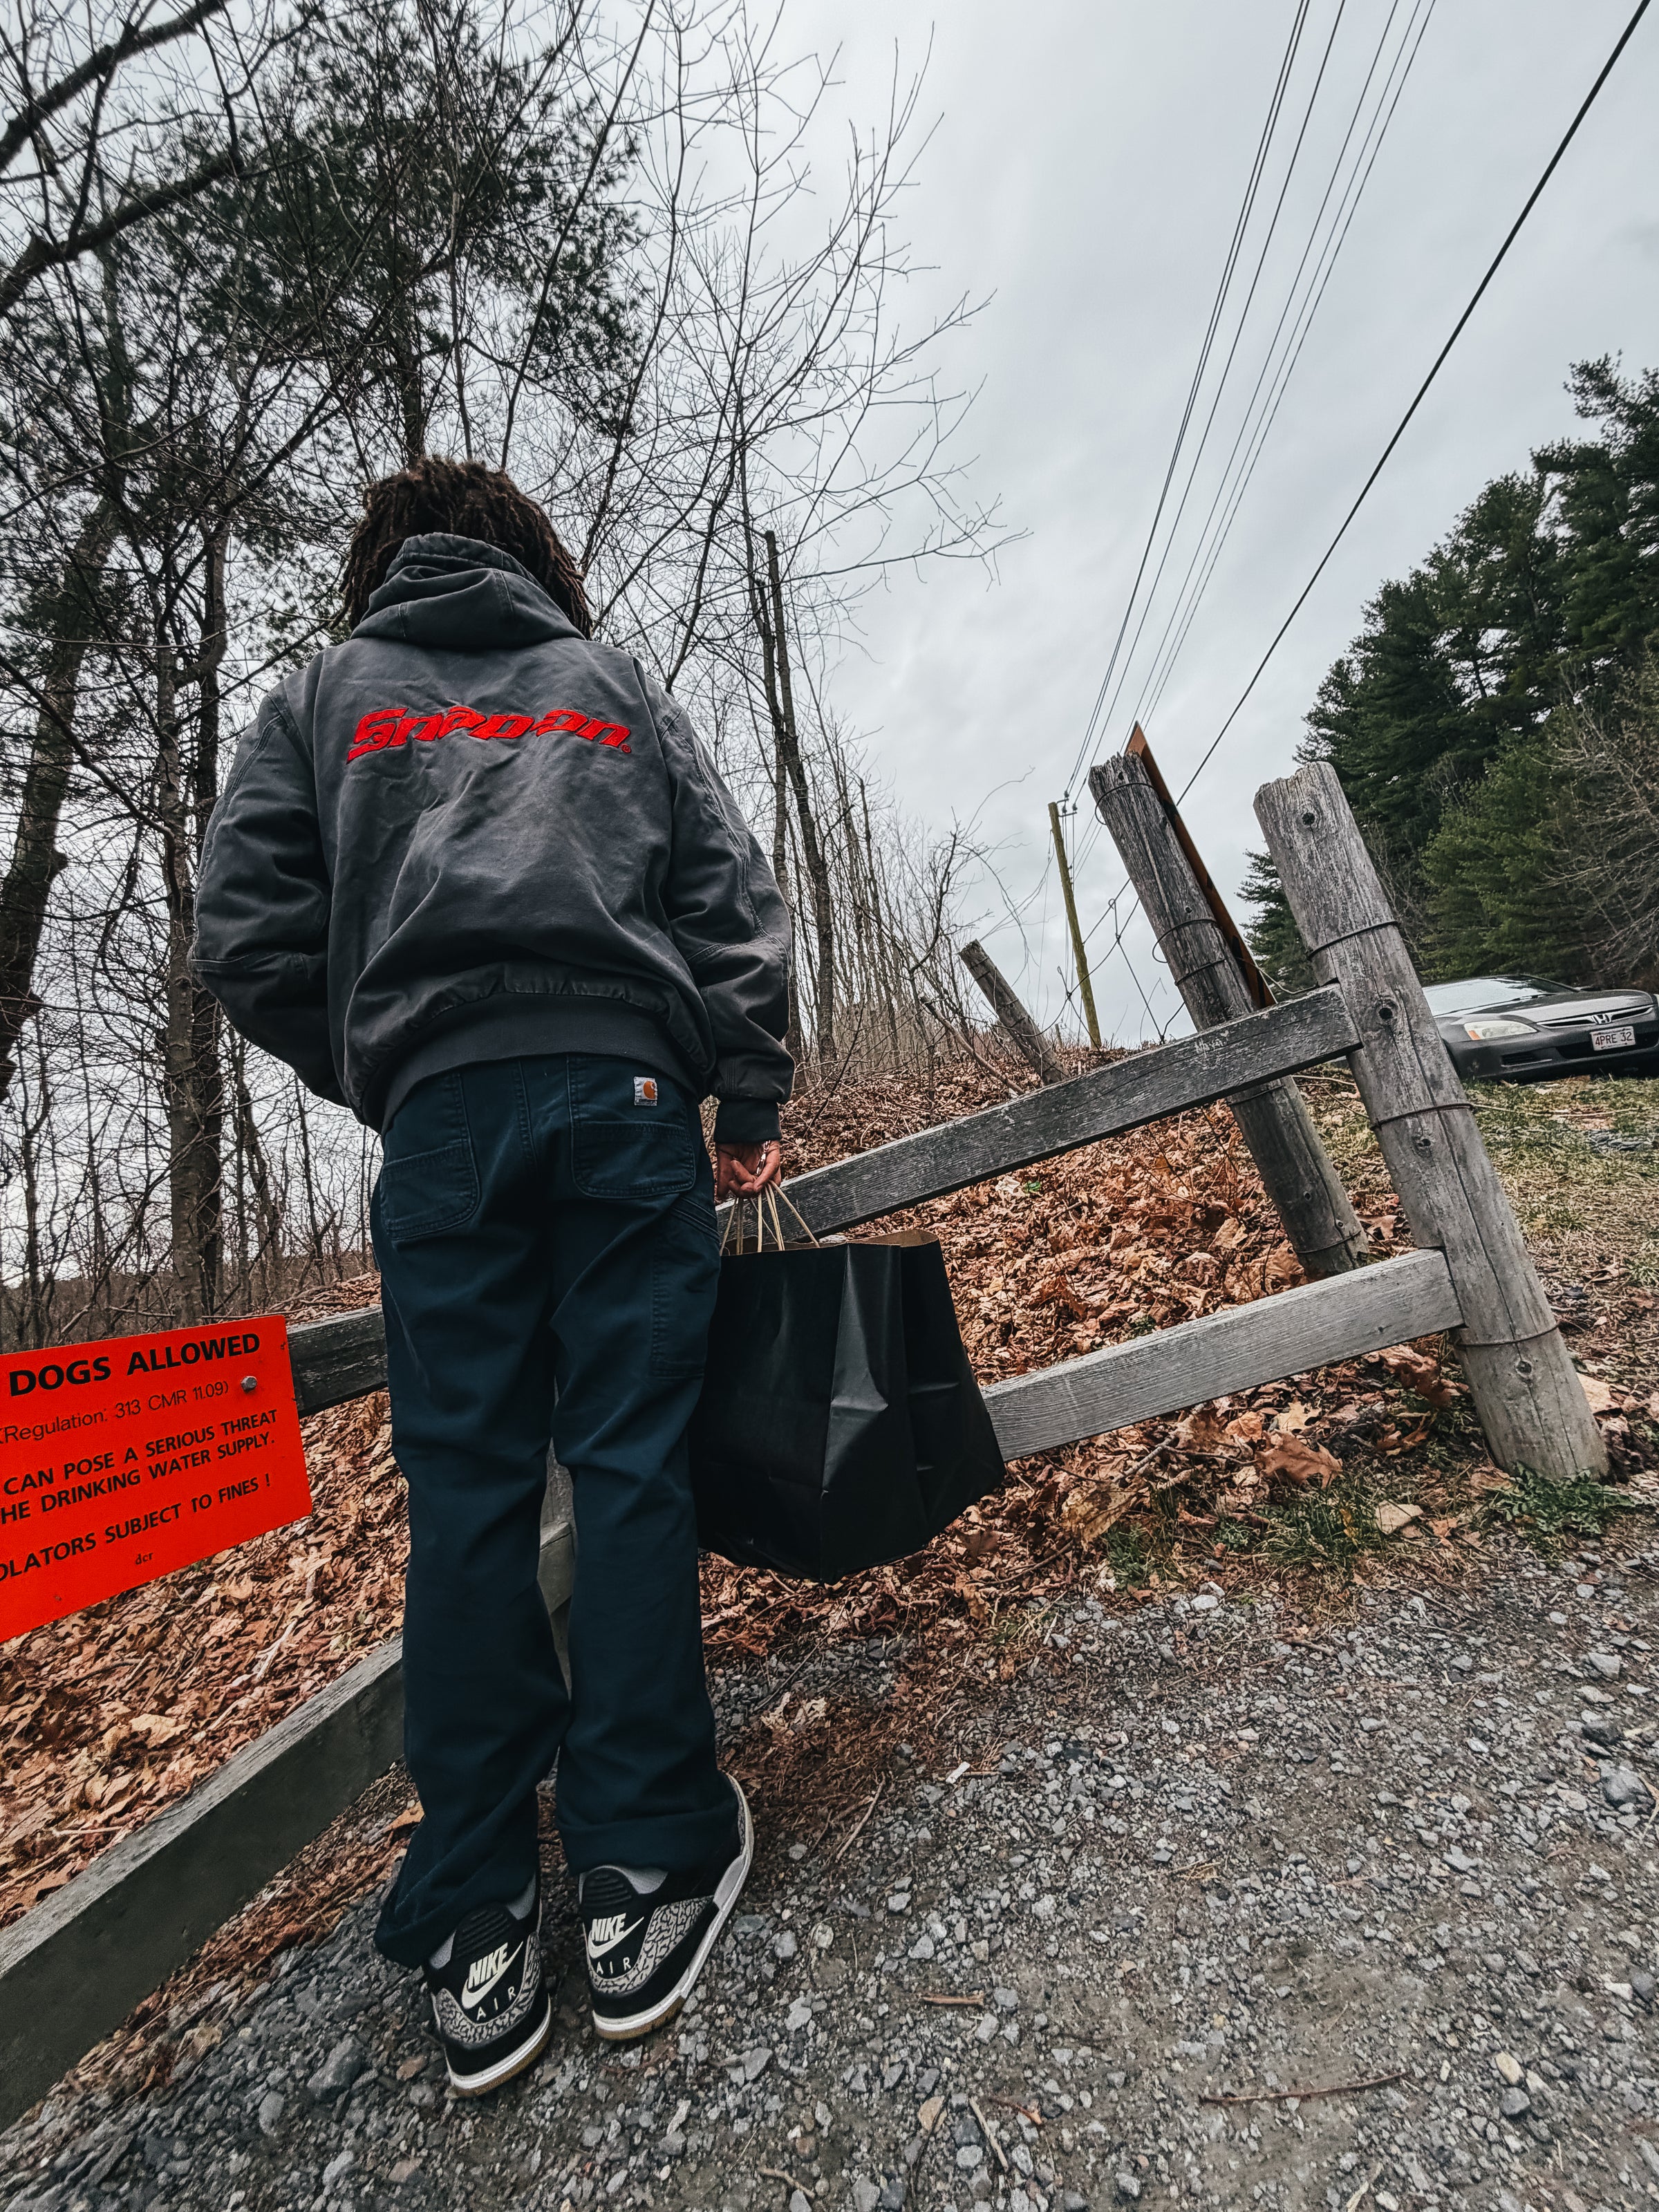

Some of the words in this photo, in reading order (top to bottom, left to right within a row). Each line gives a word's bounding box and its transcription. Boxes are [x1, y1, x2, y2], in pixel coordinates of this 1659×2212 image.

[1595, 1034, 1618, 1045] 4PRE
[1620, 1031, 1633, 1042] 32
[9, 1356, 111, 1397] DOGS
[126, 1333, 260, 1376] ALLOWED
[115, 1399, 141, 1418] 313
[148, 1389, 187, 1410] CMR
[193, 1380, 229, 1400] 11.09)
[3, 1468, 54, 1495] CAN
[64, 1452, 115, 1480] POSE
[124, 1447, 138, 1464] A
[145, 1426, 215, 1457] SERIOUS
[221, 1409, 277, 1436] THREAT
[1, 1500, 31, 1524] HE
[41, 1469, 141, 1512] DRINKING
[148, 1449, 212, 1479] WATER
[217, 1432, 275, 1459] SUPPLY.
[104, 1503, 182, 1544] SUBJECT
[191, 1494, 212, 1512] TO
[218, 1477, 259, 1503] FINES
[135, 1552, 154, 1565] dcr
[591, 1913, 626, 1942] NIKE
[468, 1942, 508, 1989] NIKE
[596, 1956, 632, 1975] AIR
[476, 1986, 516, 2021] AIR
